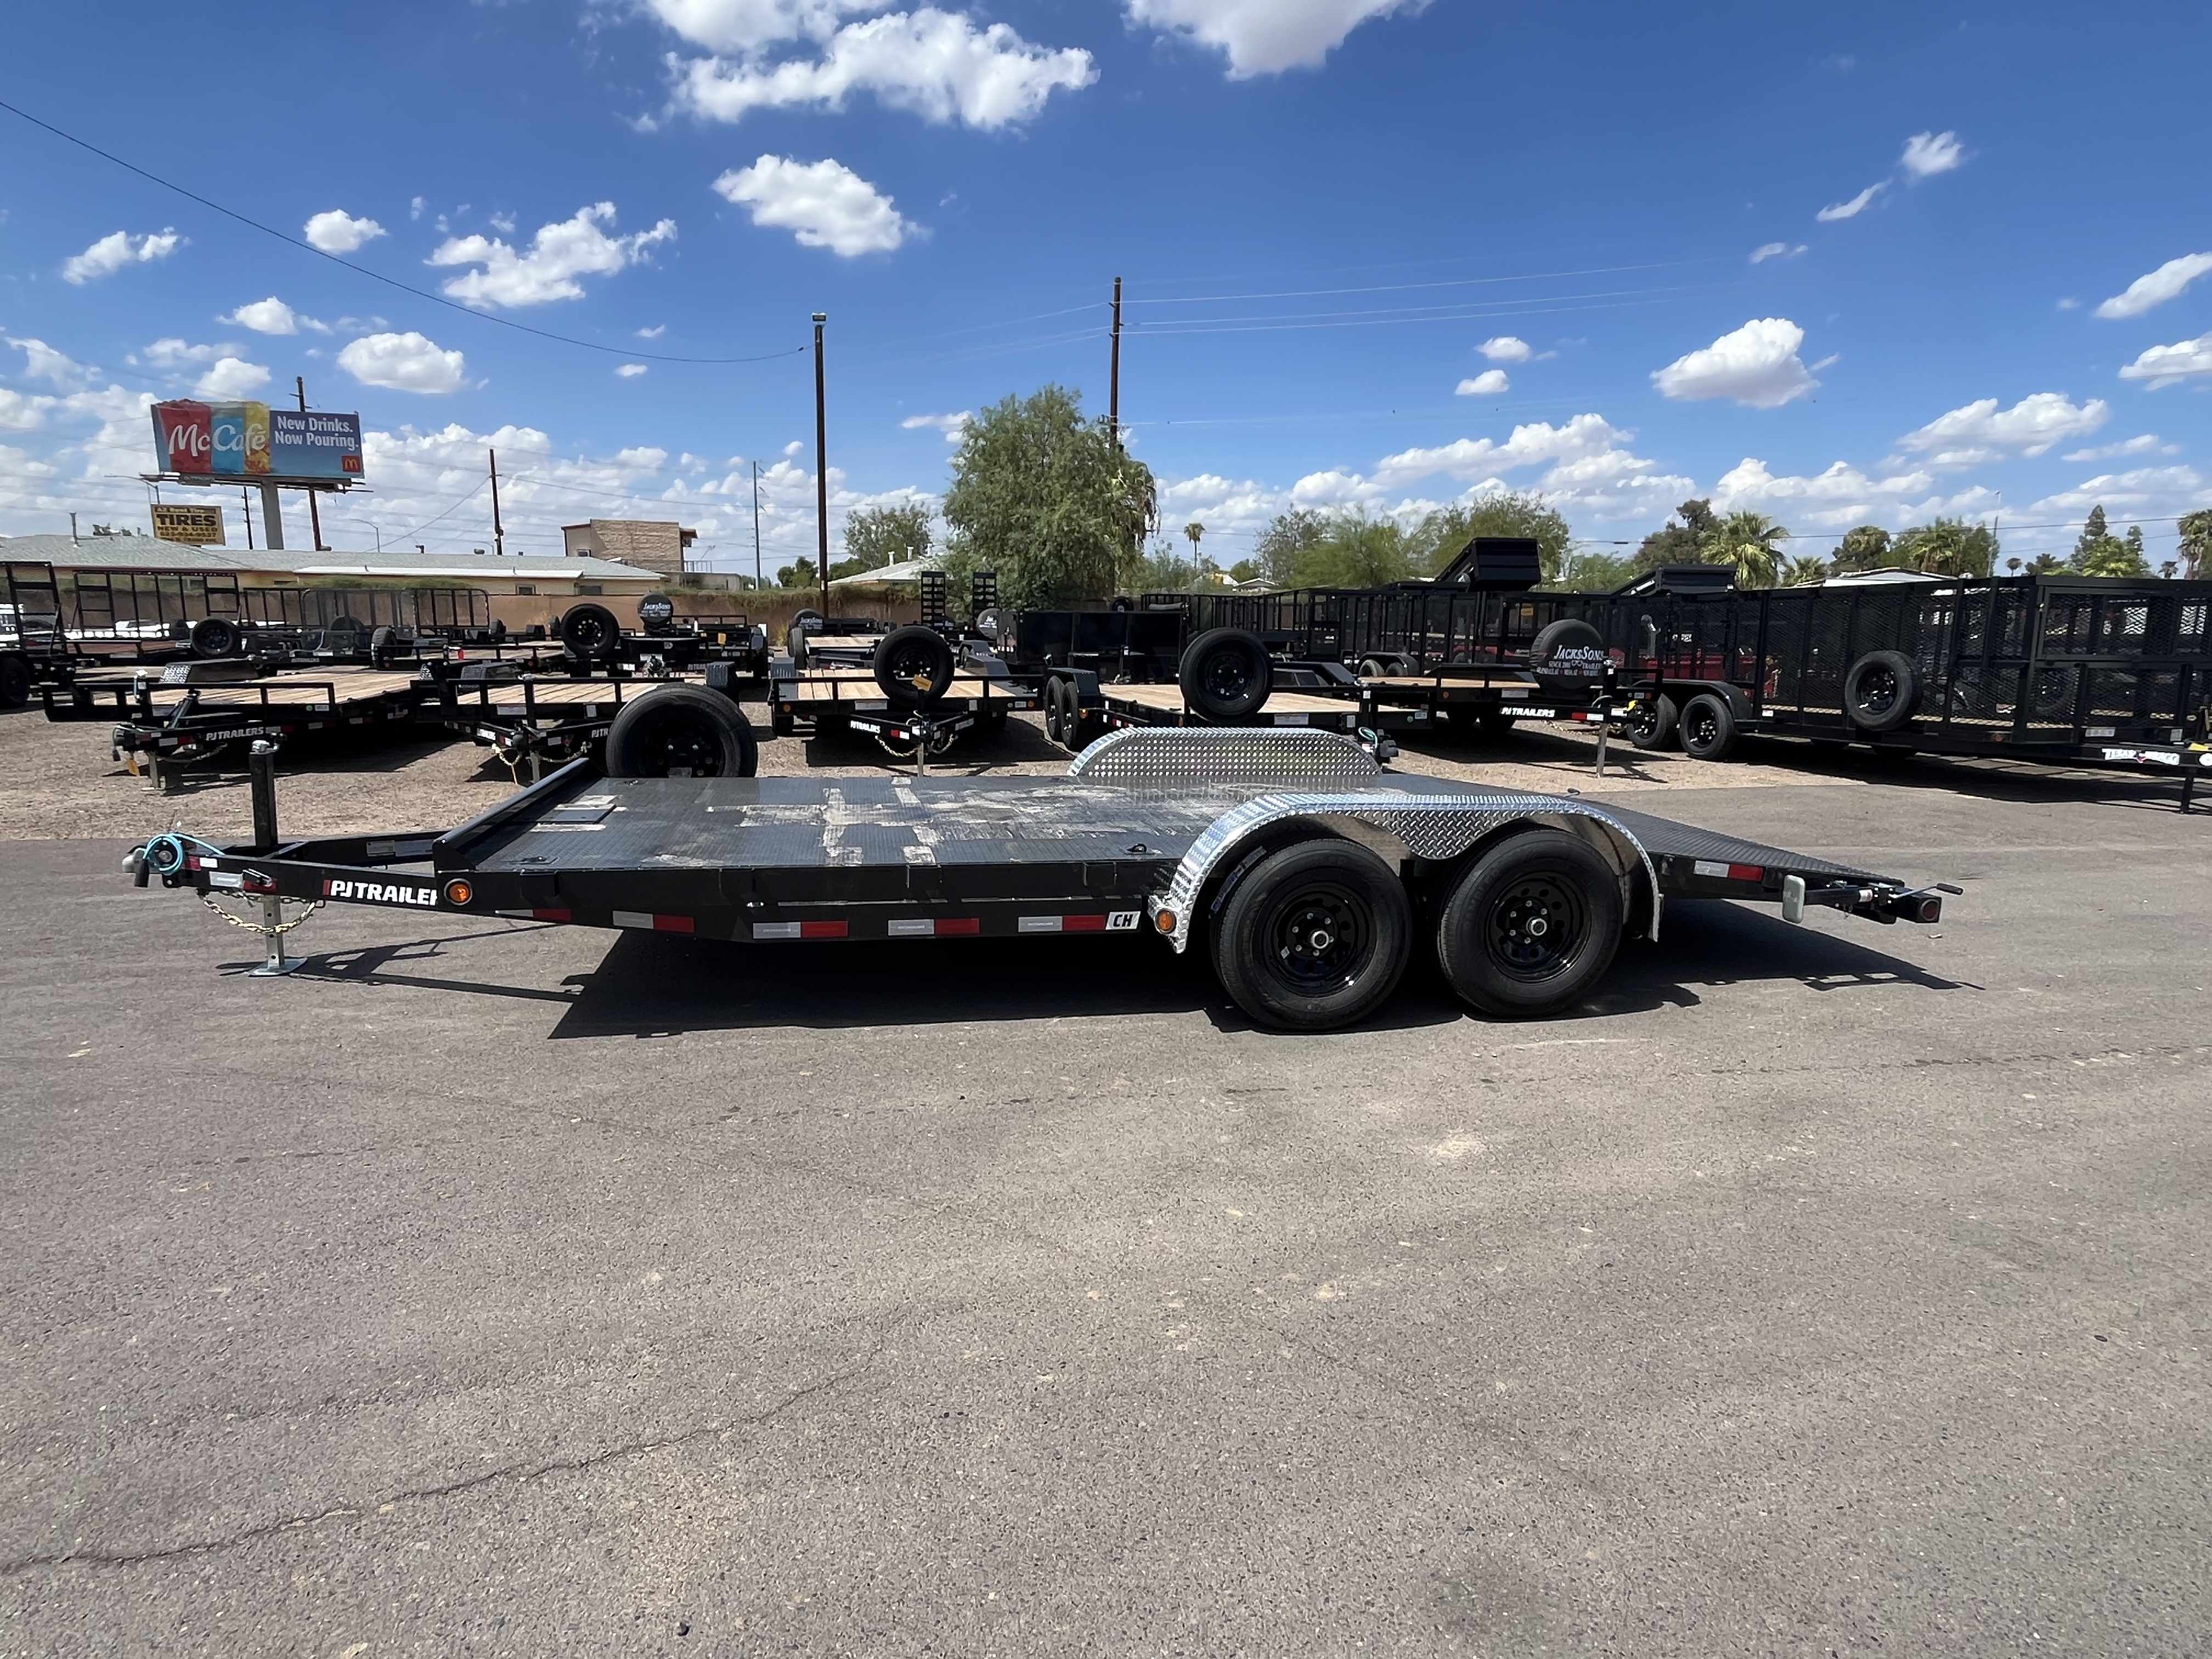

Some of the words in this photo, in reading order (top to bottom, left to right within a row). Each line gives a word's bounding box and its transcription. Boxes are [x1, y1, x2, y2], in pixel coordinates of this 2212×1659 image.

[277, 416, 306, 430] New
[308, 417, 353, 432] Drinks.
[275, 431, 303, 444] Now
[306, 432, 359, 451] Pouring.
[156, 514, 216, 526] TIRES
[1113, 914, 1133, 927] CH
